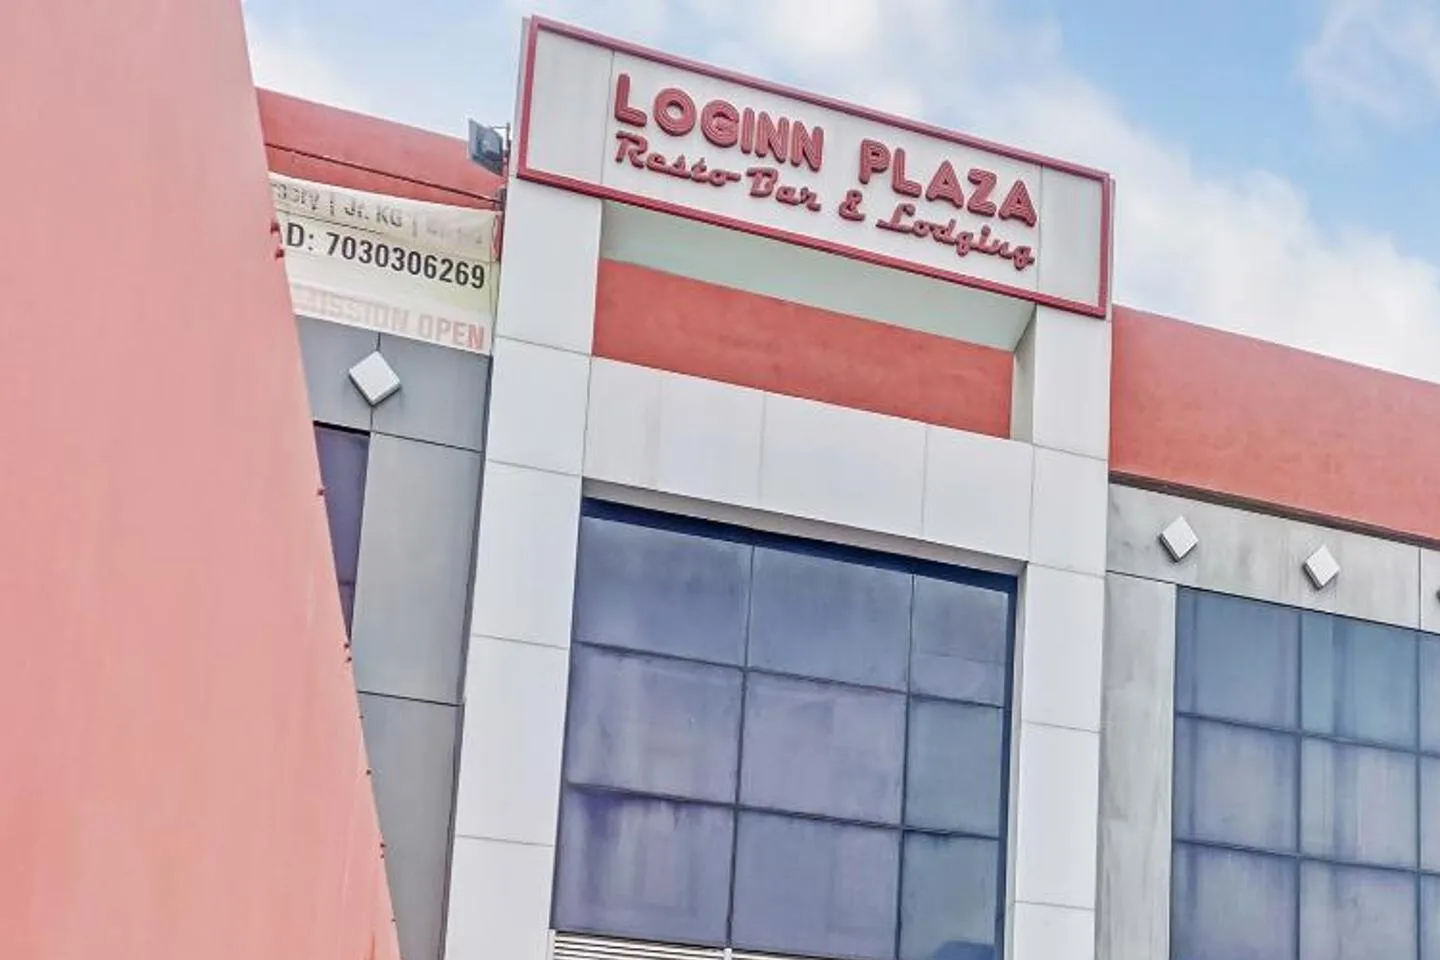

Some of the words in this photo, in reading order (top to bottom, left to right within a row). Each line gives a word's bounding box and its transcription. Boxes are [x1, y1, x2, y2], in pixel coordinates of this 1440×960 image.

[615, 73, 824, 172] LOGINN
[858, 138, 1037, 227] PLAZA
[326, 231, 485, 289] 7030306269
[838, 189, 865, 221] &
[876, 203, 1035, 271] Lodging
[418, 313, 485, 350] OPEN
